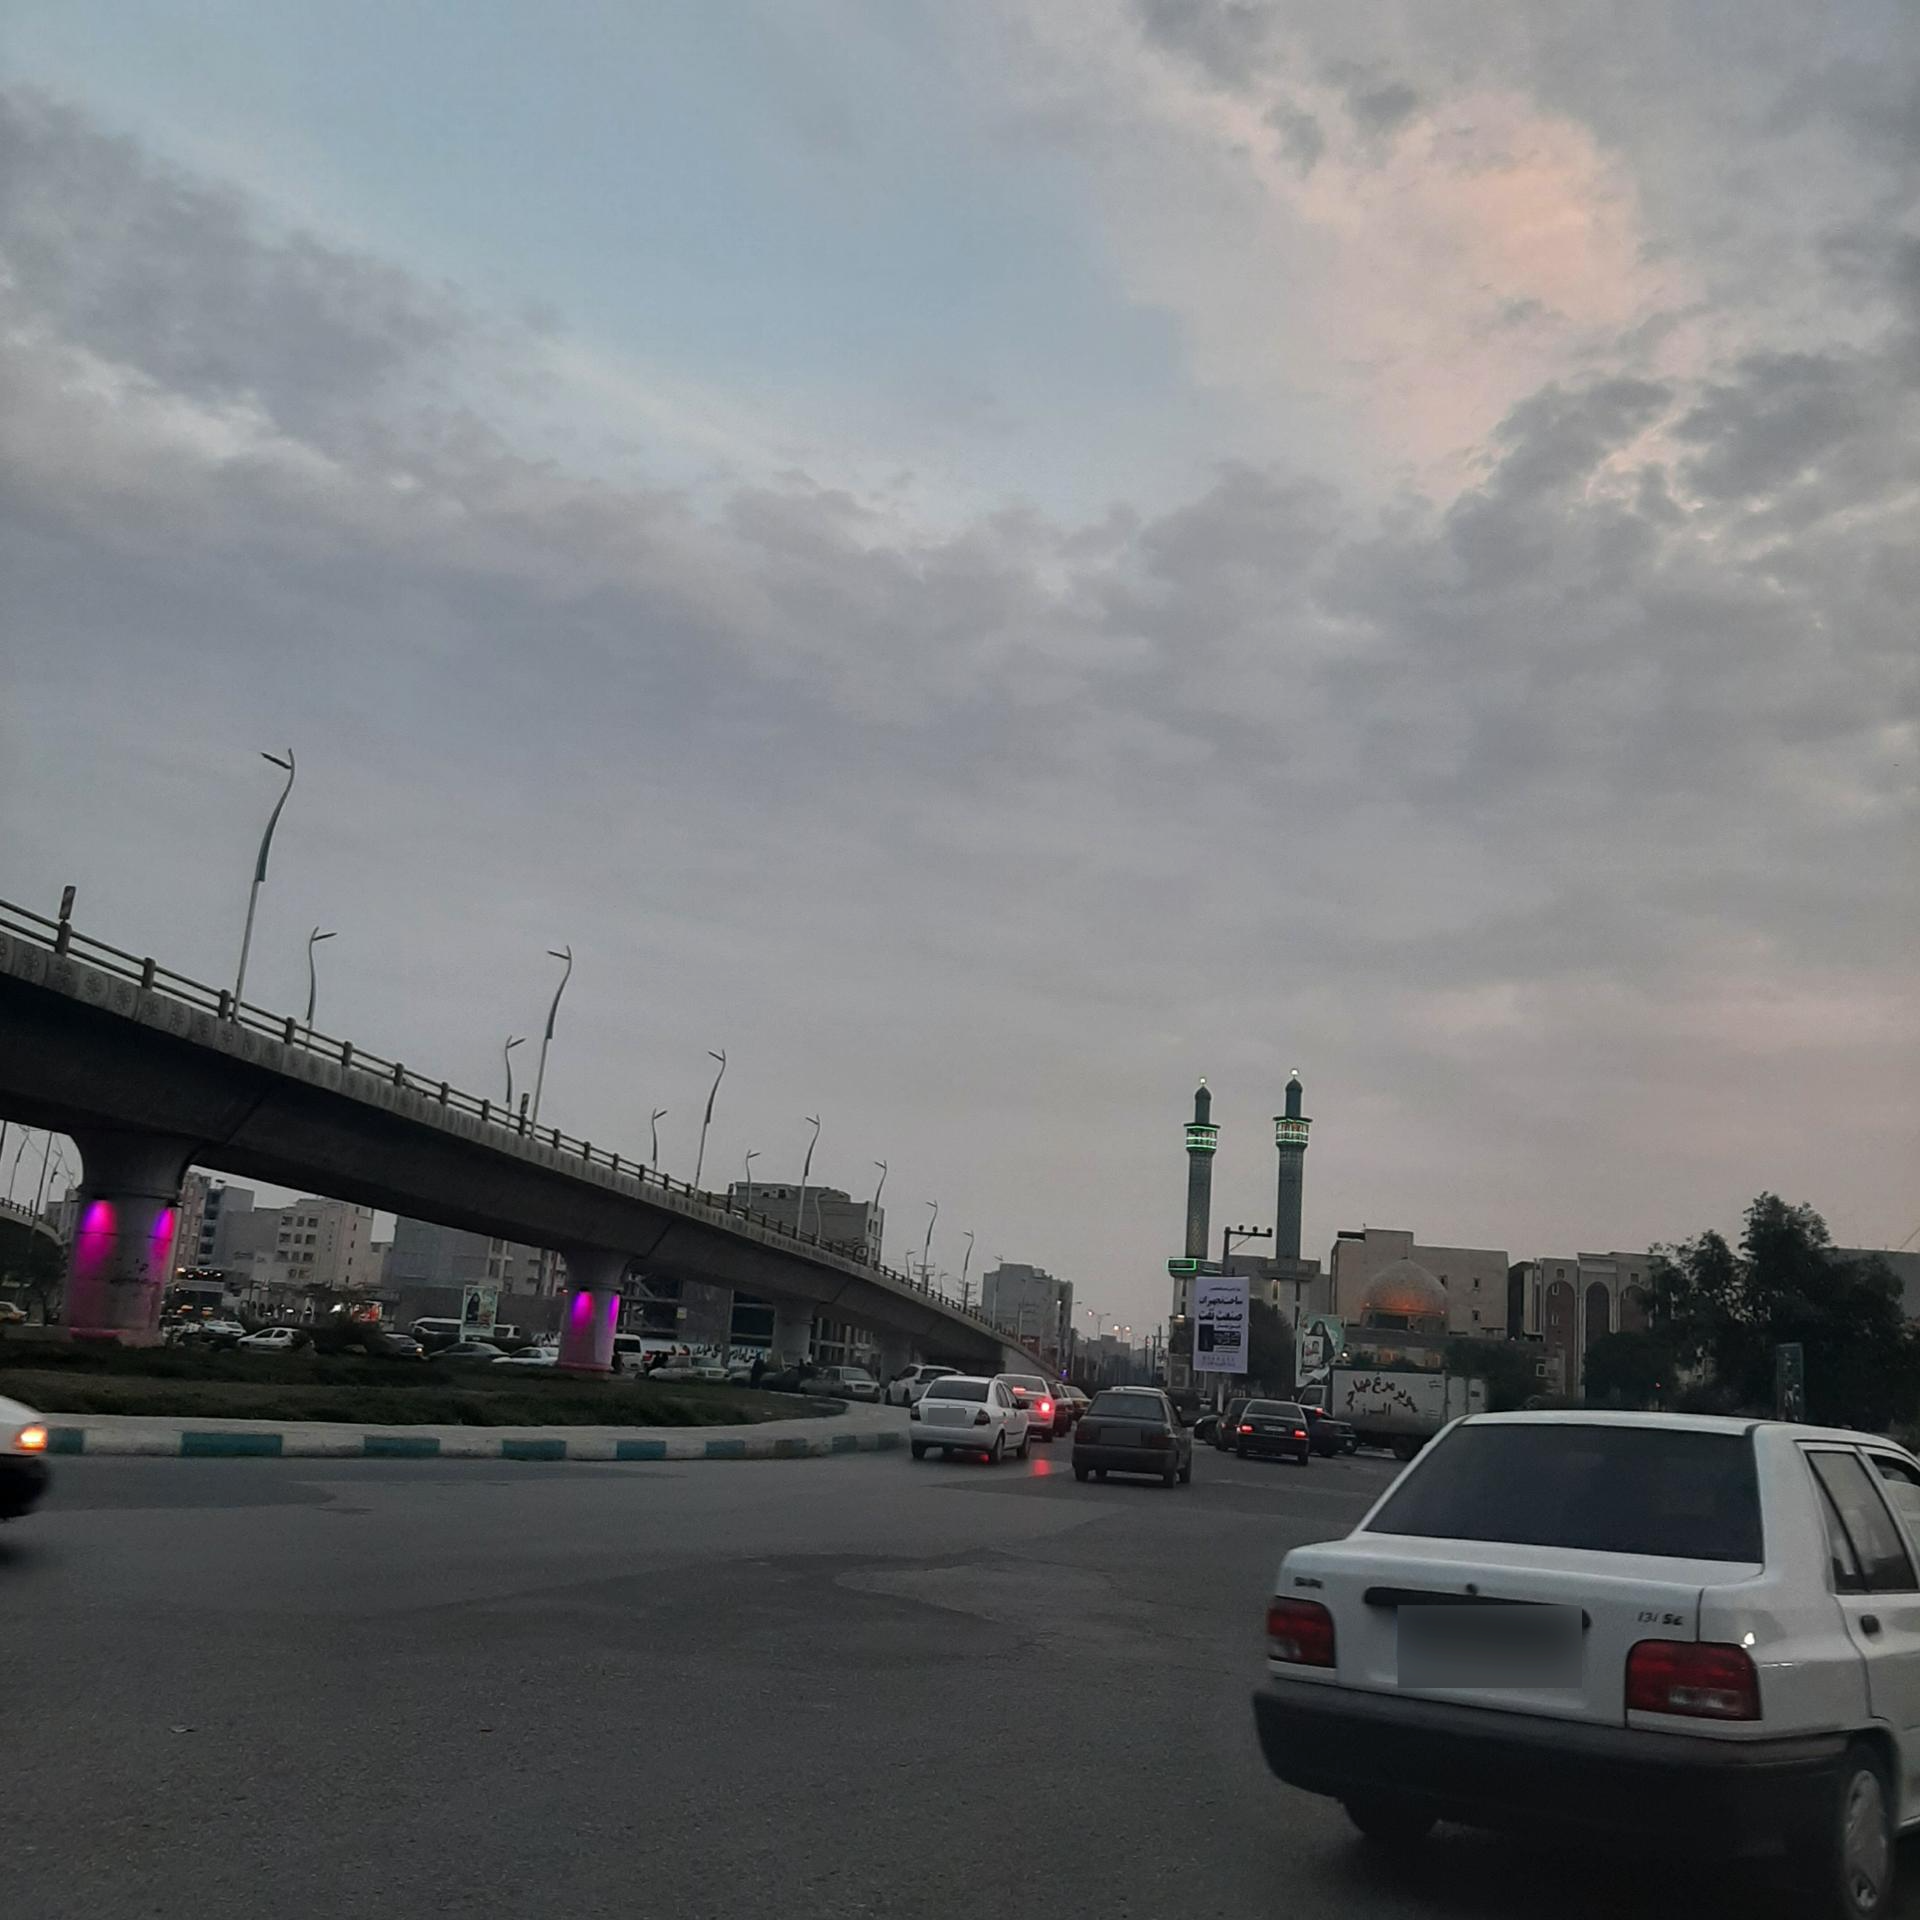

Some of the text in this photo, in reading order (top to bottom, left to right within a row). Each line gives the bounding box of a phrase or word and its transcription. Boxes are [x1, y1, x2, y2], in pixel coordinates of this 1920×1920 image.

[1198, 1308, 1243, 1321] صنعت نفت
[1371, 1372, 1396, 1394] مرغ
